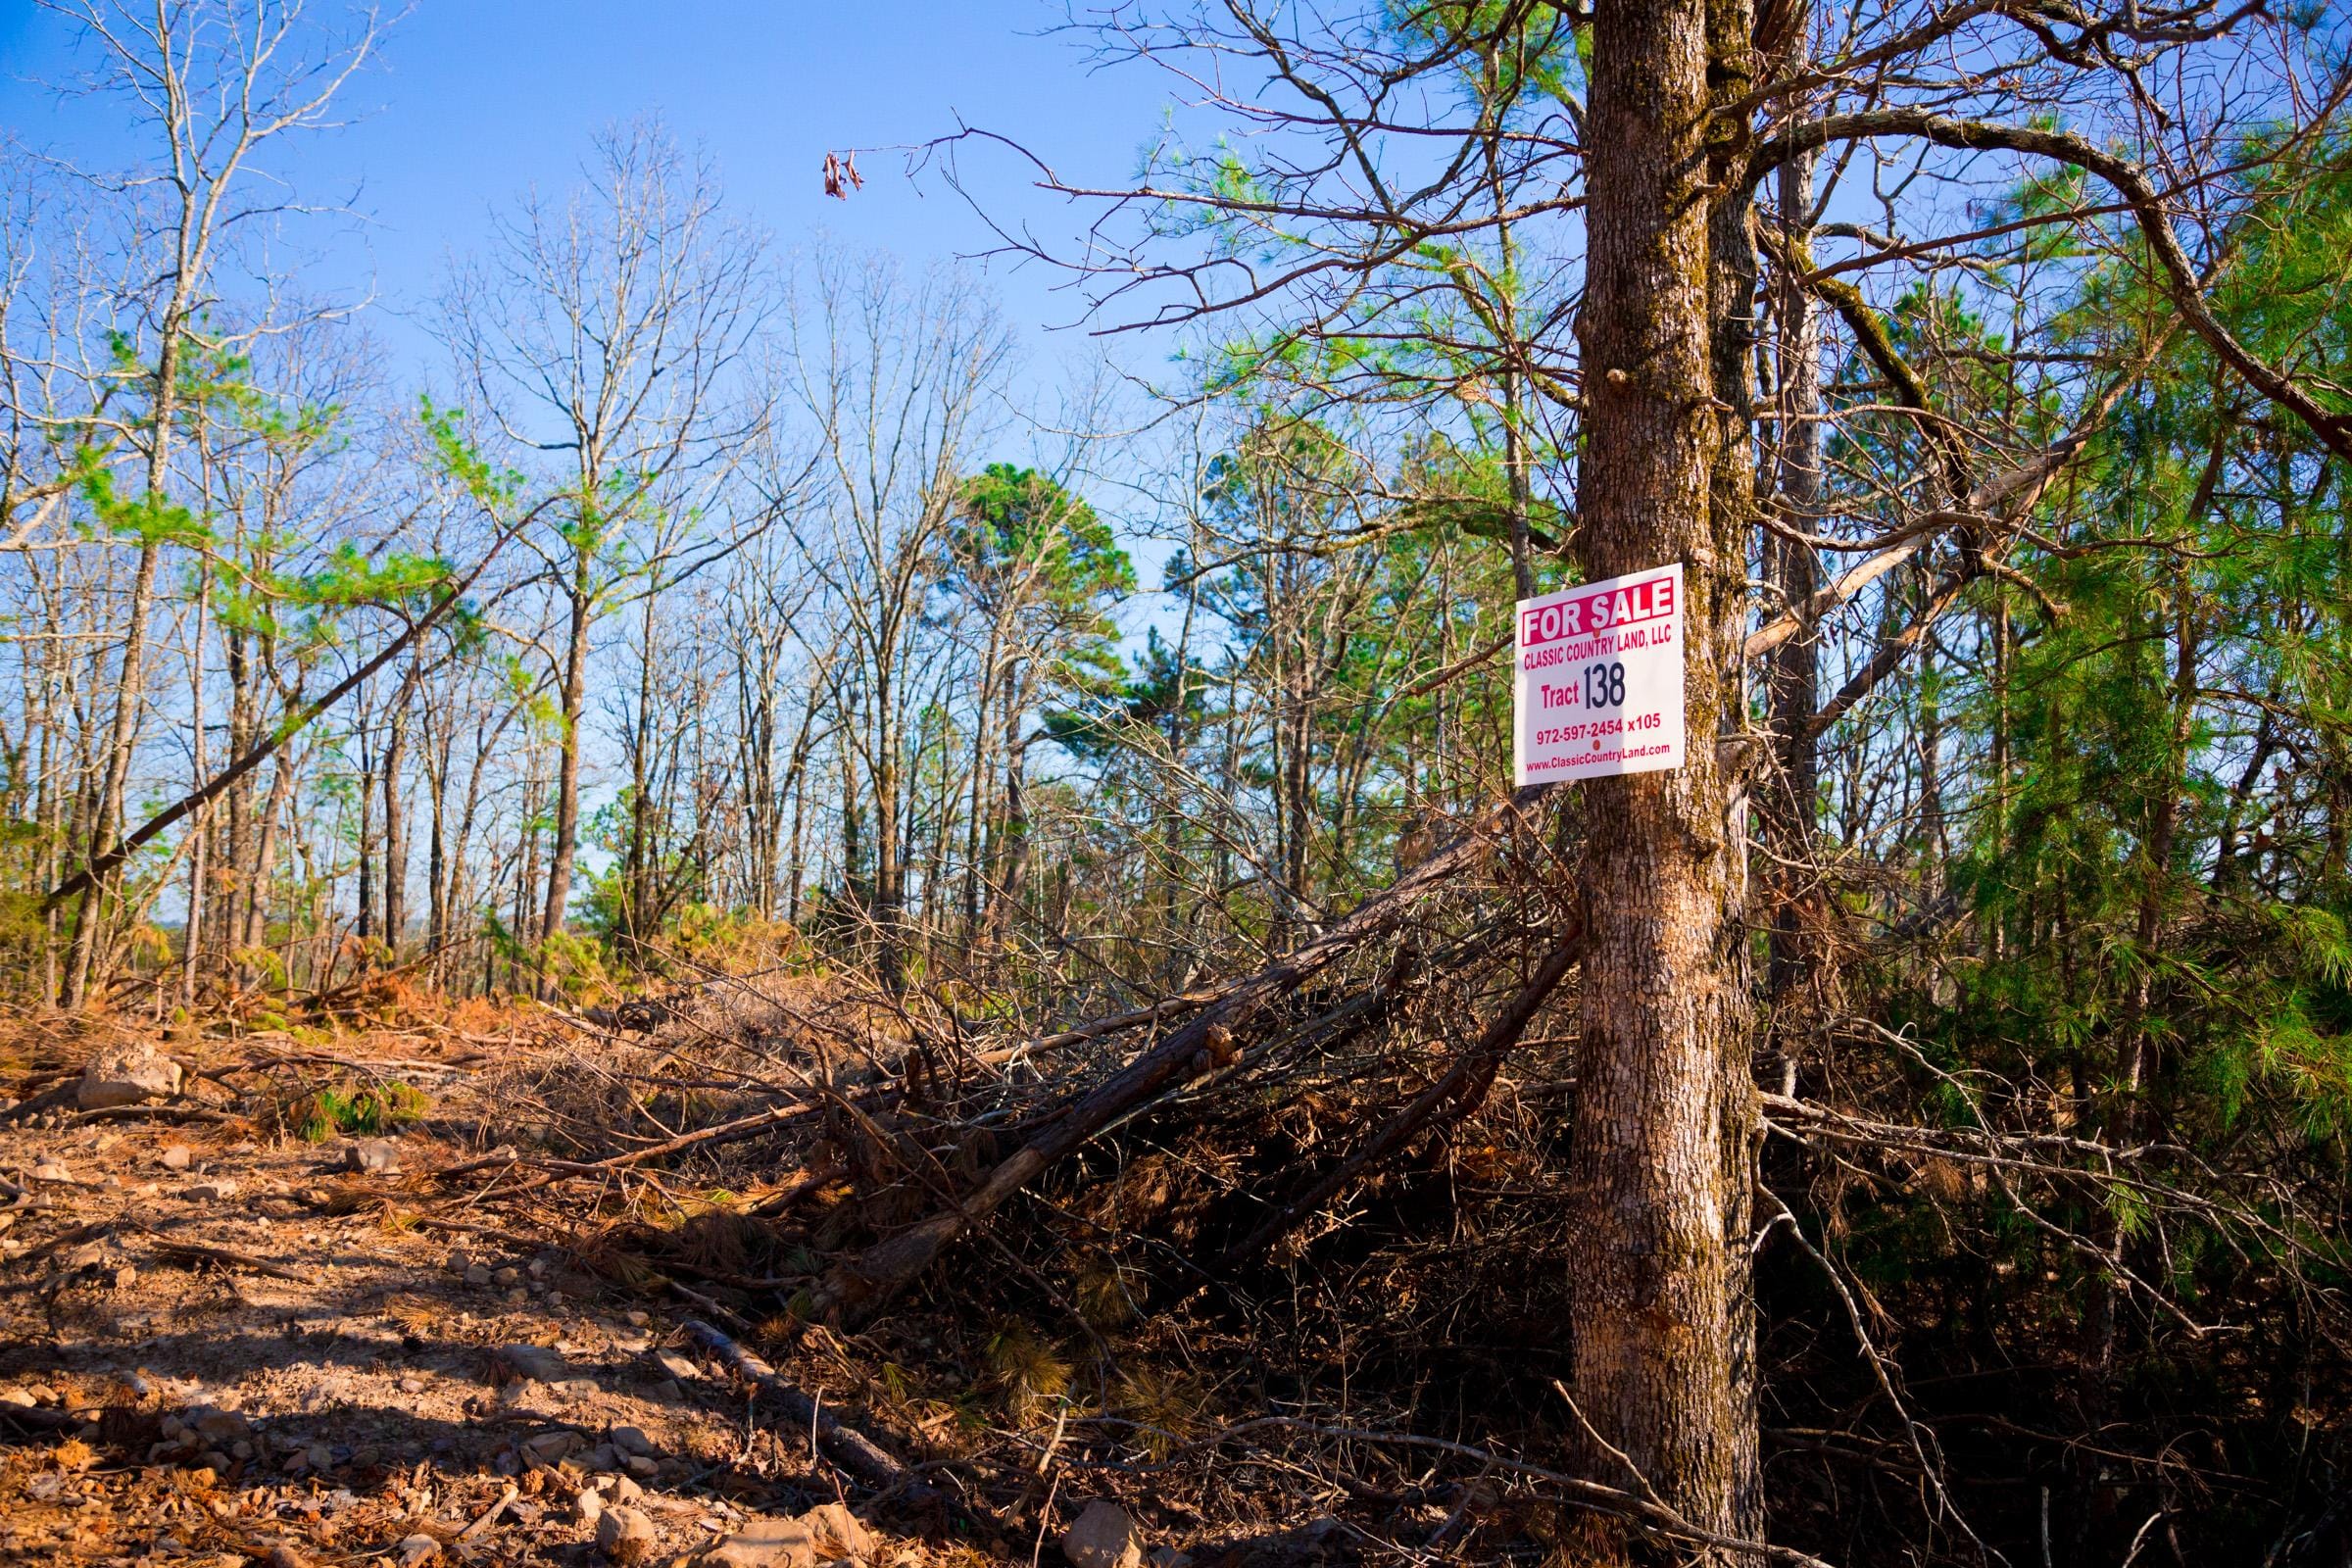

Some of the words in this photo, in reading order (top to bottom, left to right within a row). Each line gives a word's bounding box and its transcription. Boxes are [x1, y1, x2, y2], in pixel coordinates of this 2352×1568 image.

[1524, 603, 1581, 644] FOR
[1592, 580, 1671, 628] SALE
[1524, 646, 1563, 670] CLASSIC
[1566, 635, 1614, 662] COUNTRY
[1617, 629, 1648, 651] LAND,
[1651, 623, 1671, 644] LLC
[1542, 679, 1579, 709] Tract
[1584, 662, 1626, 710] 138
[1537, 718, 1623, 745] 972-597-2454
[1627, 712, 1661, 732] x105
[1526, 744, 1670, 771] www.ClassicCountryLand.com
